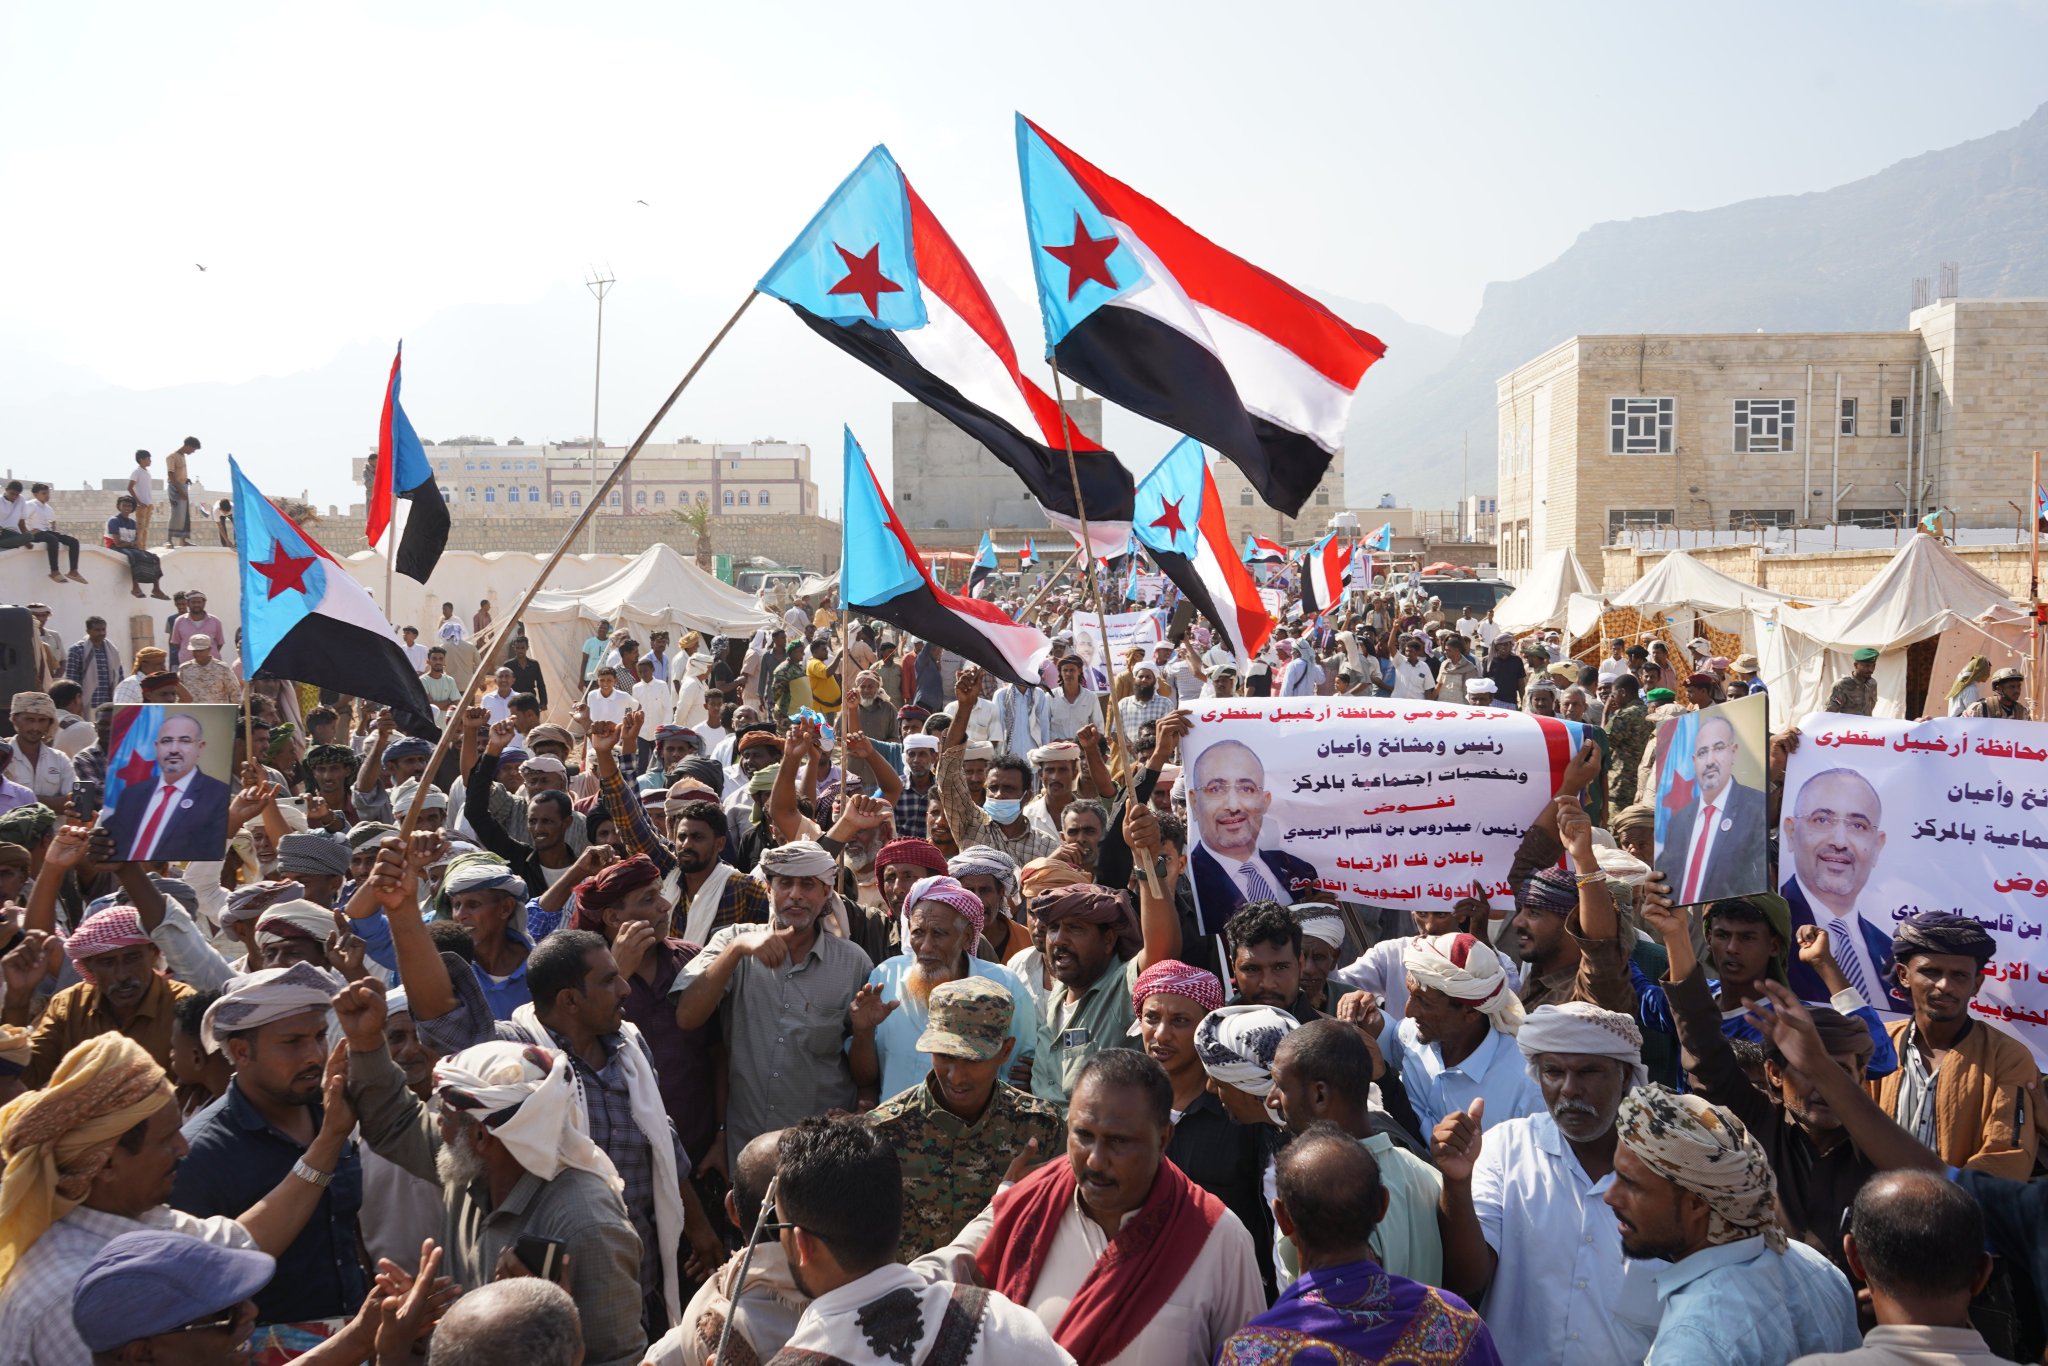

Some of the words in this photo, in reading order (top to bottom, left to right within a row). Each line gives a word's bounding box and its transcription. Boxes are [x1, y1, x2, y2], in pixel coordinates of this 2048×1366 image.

[1201, 707, 1263, 723] سقطرى
[1269, 704, 1331, 723] أرخبيل
[1337, 707, 1397, 719] محافظة
[1403, 708, 1458, 723] مومي
[1465, 709, 1510, 720] مركز
[1317, 734, 1372, 758] وأعيان
[1378, 736, 1446, 757] ومشائخ
[1454, 735, 1504, 755] رئيس
[1815, 730, 1885, 747] سقطرى
[1893, 732, 1968, 757] أرخبيل
[1975, 737, 2048, 762] محافظة
[1292, 774, 1345, 792] بالمركز
[1351, 770, 1432, 791] إجتماعية
[1438, 767, 1528, 785] وشخصيات
[1948, 780, 2014, 808] وأعيان
[1283, 826, 1341, 843] الزبيدي
[1345, 823, 1382, 839] قاسم
[1386, 826, 1405, 836] بن
[1409, 822, 1471, 835] عيدروس
[1912, 818, 1976, 845] بالمركز
[1336, 853, 1398, 872] الارتباط
[1404, 853, 1428, 867] فك
[1434, 850, 1484, 868] بإعلان
[1353, 884, 1421, 902] الجنوبية
[1427, 882, 1477, 901] الدولة
[2018, 921, 2042, 940] بن
